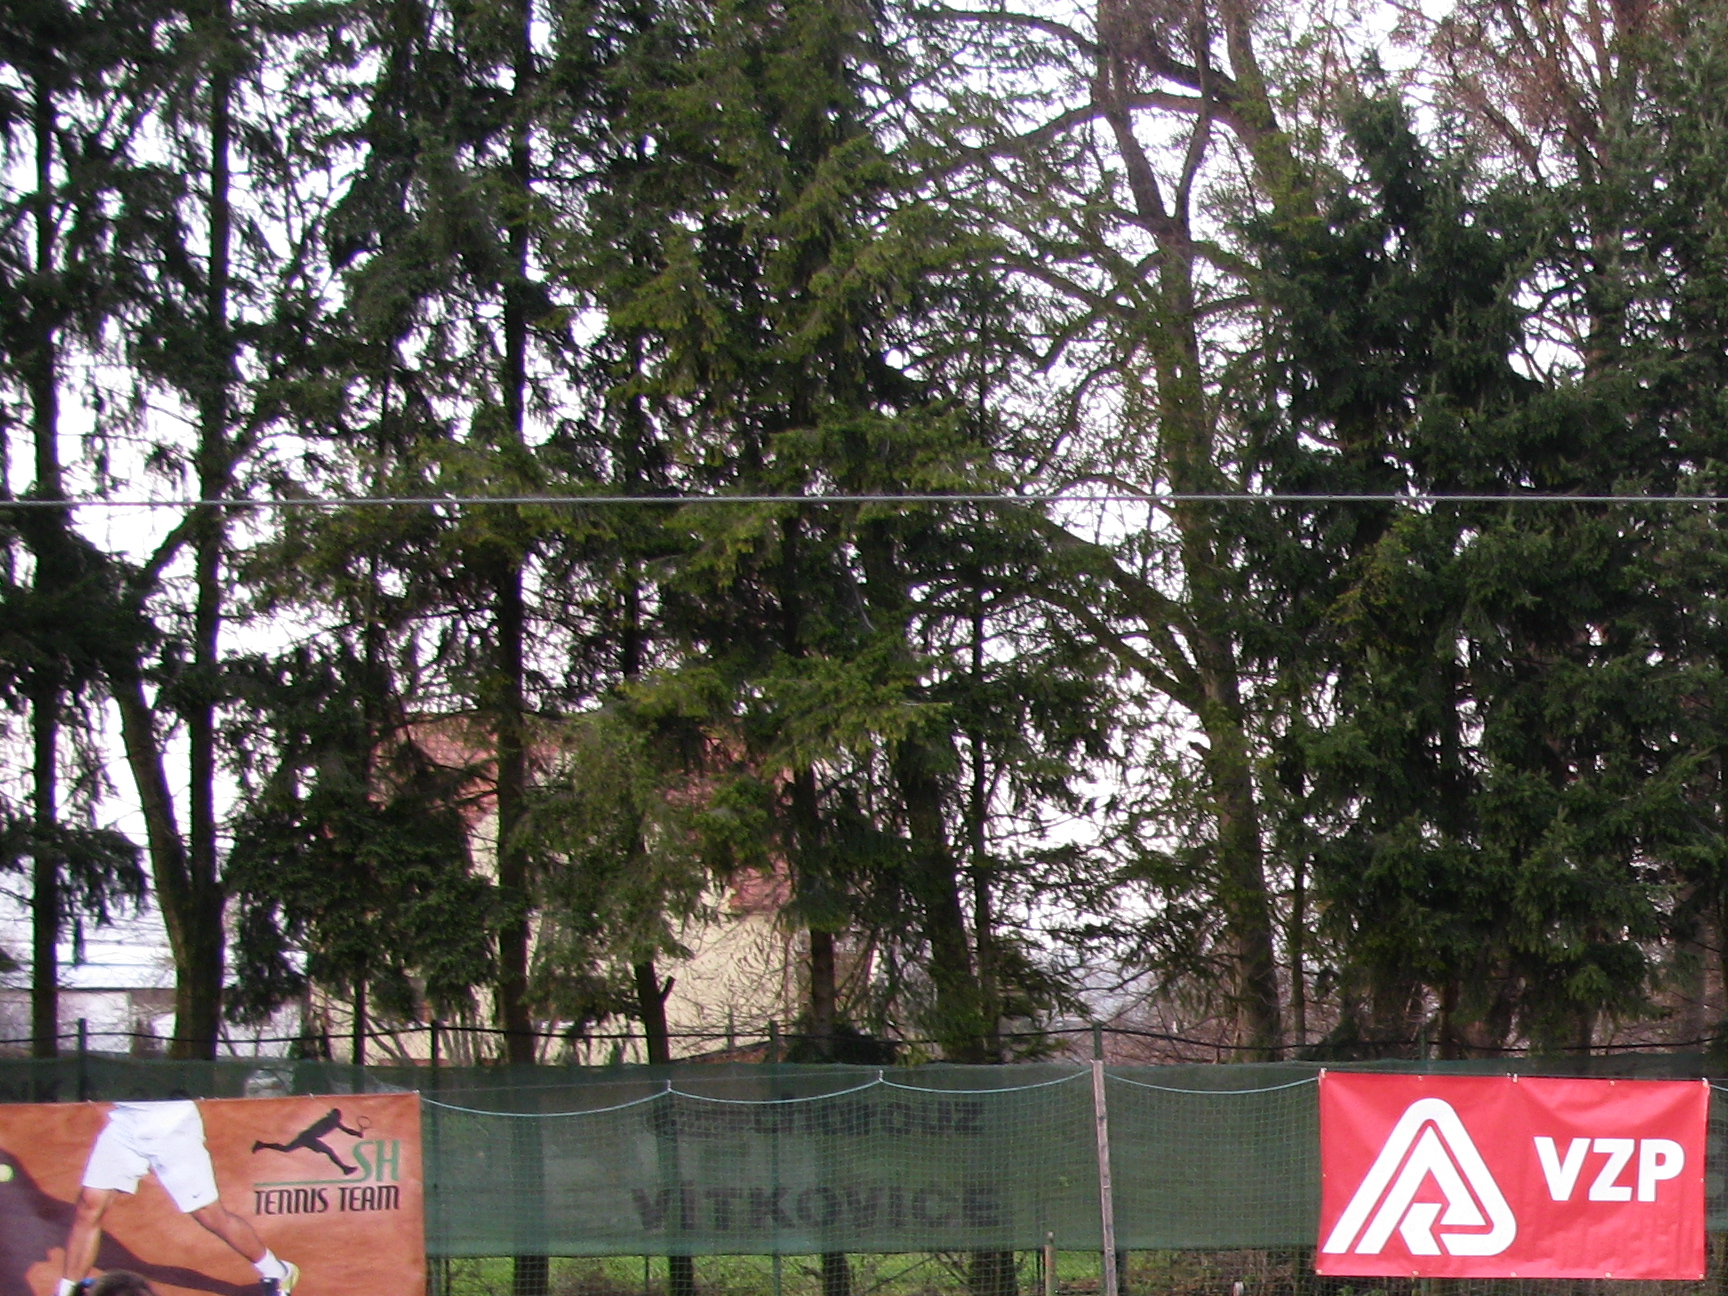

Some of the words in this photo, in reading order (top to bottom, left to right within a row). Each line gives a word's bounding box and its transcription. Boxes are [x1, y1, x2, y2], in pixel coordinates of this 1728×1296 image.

[352, 1139, 400, 1182] SH
[1532, 1135, 1686, 1203] VZP
[254, 1187, 329, 1216] TENNIS
[338, 1184, 400, 1212] TEAM
